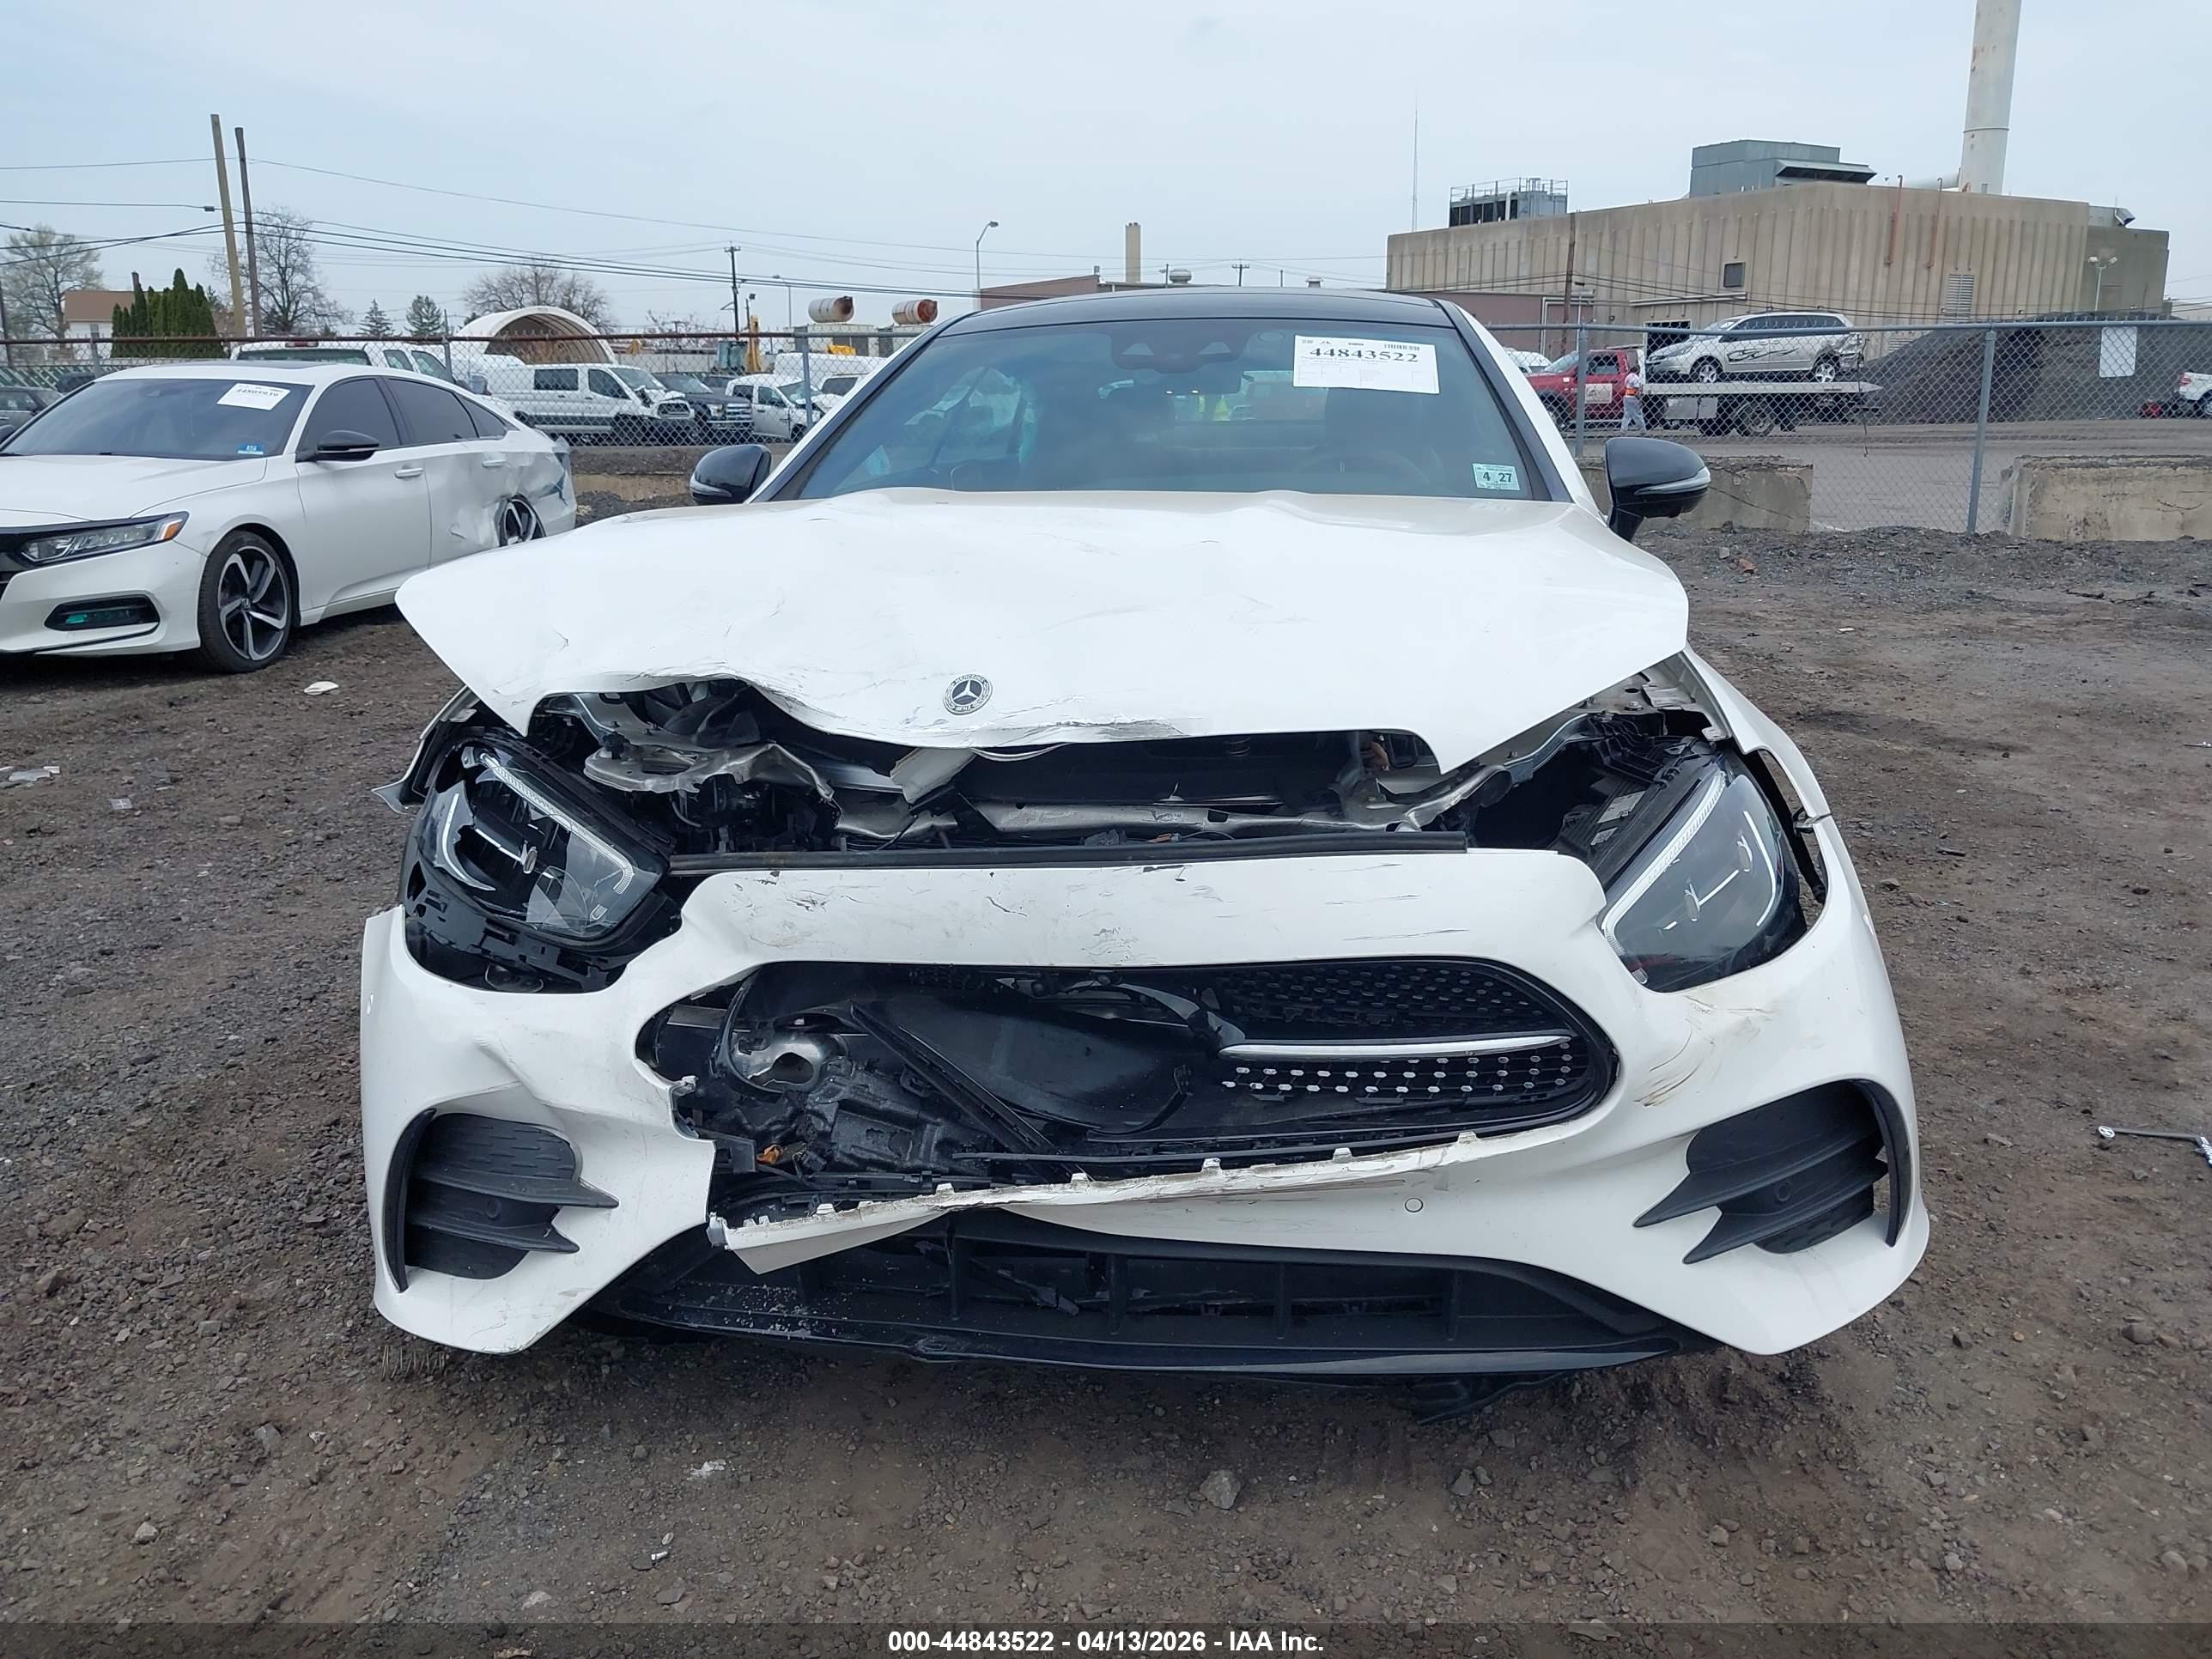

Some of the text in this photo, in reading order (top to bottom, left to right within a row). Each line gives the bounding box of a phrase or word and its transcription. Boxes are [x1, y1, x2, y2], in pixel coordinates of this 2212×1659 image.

[1310, 347, 1419, 362] 44843522
[1482, 471, 1512, 483] 4 27
